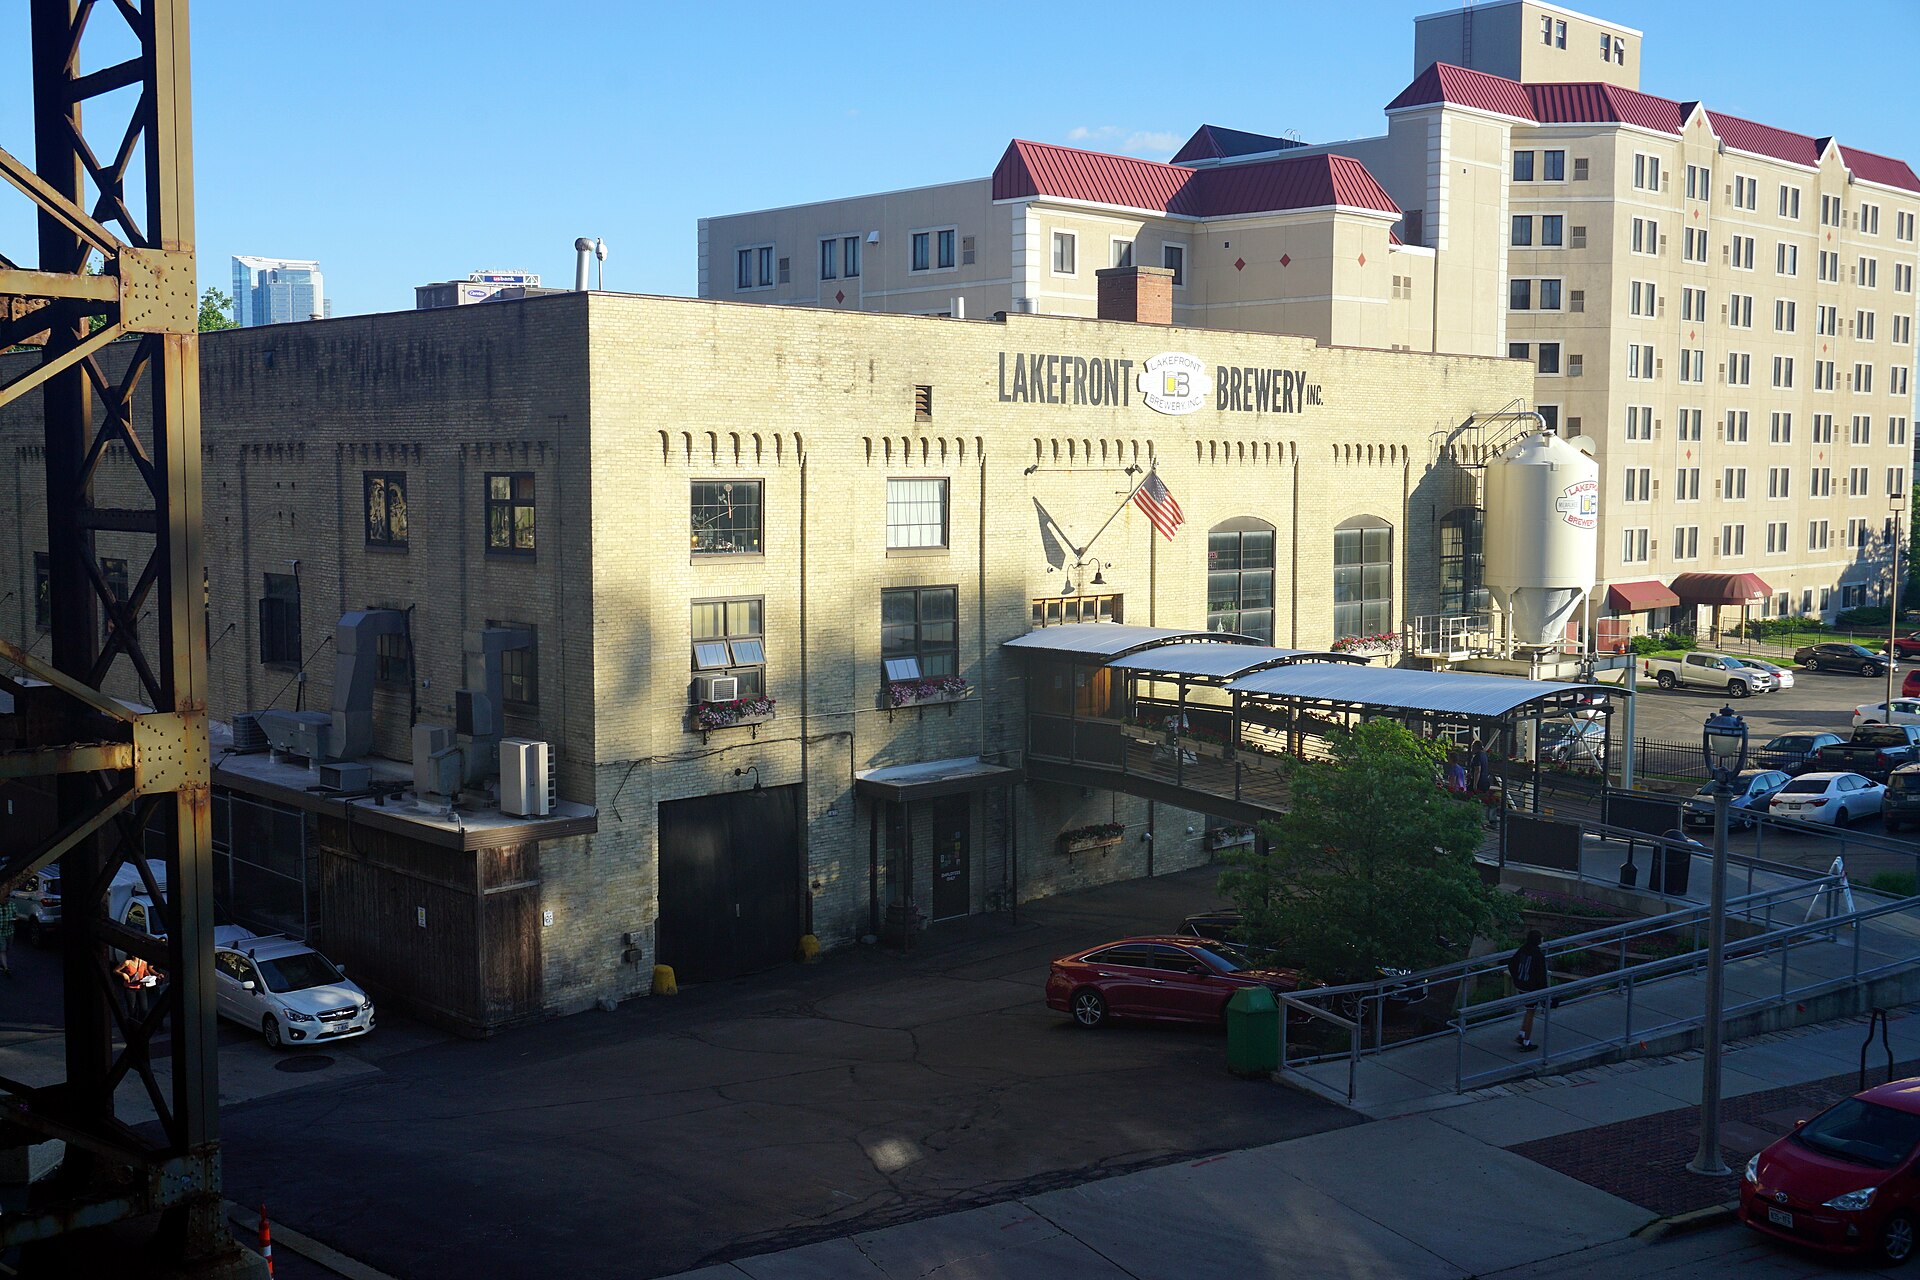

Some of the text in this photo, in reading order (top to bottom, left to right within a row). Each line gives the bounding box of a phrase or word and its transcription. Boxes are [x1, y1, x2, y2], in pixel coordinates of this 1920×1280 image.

[998, 352, 1324, 414] LAKEFRONT BREWERY INC.
[1150, 356, 1202, 373] LAKEFRONT
